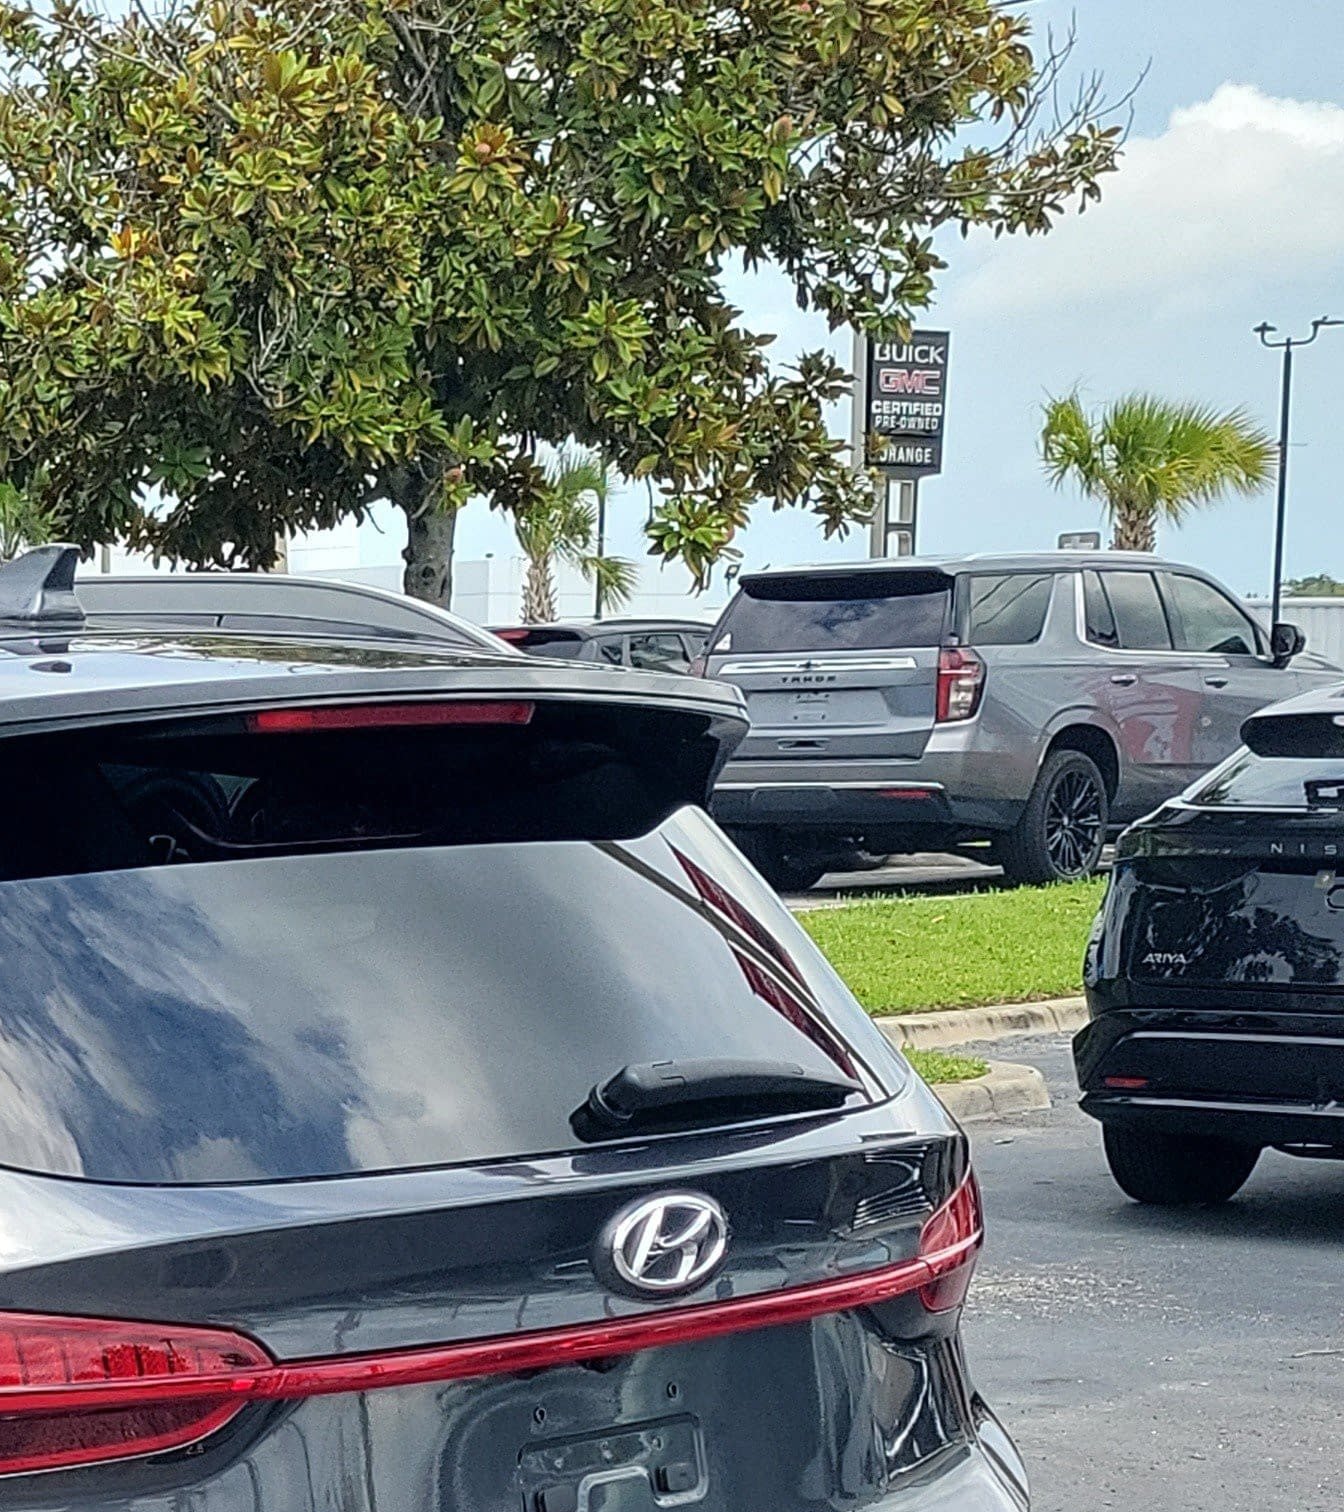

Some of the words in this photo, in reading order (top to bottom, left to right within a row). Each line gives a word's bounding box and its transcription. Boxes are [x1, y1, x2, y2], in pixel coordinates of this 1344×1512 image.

[873, 343, 944, 364] BUICK
[879, 368, 941, 395] GMC
[871, 400, 943, 417] CERTIFIED
[874, 415, 939, 431] PRE-OWNED
[781, 675, 837, 683] TAHOE
[1142, 953, 1188, 965] ARIYA
